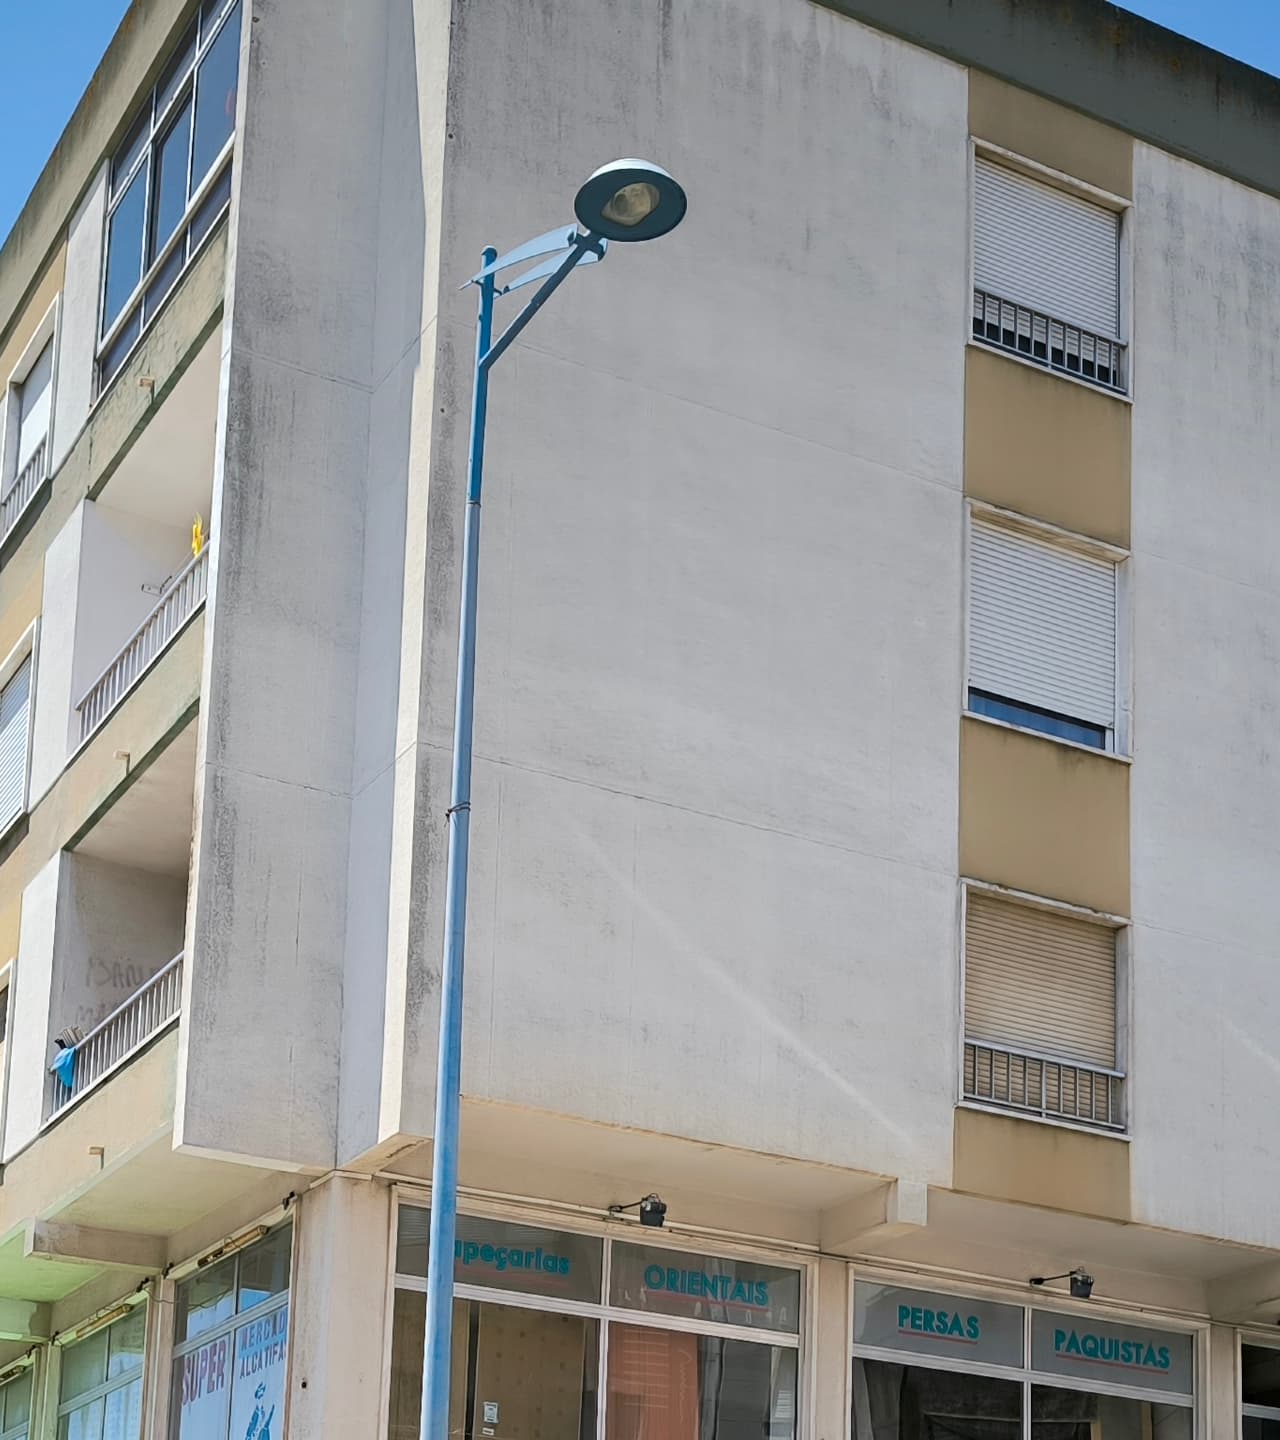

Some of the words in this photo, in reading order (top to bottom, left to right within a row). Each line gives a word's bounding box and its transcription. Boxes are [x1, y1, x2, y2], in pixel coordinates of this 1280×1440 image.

[454, 1239, 570, 1275] apeçarias
[644, 1264, 769, 1305] ORIENTAIS
[898, 1304, 980, 1340] PERSAS
[1054, 1329, 1170, 1370] PAQUISTAS
[182, 1339, 227, 1406] SUPER
